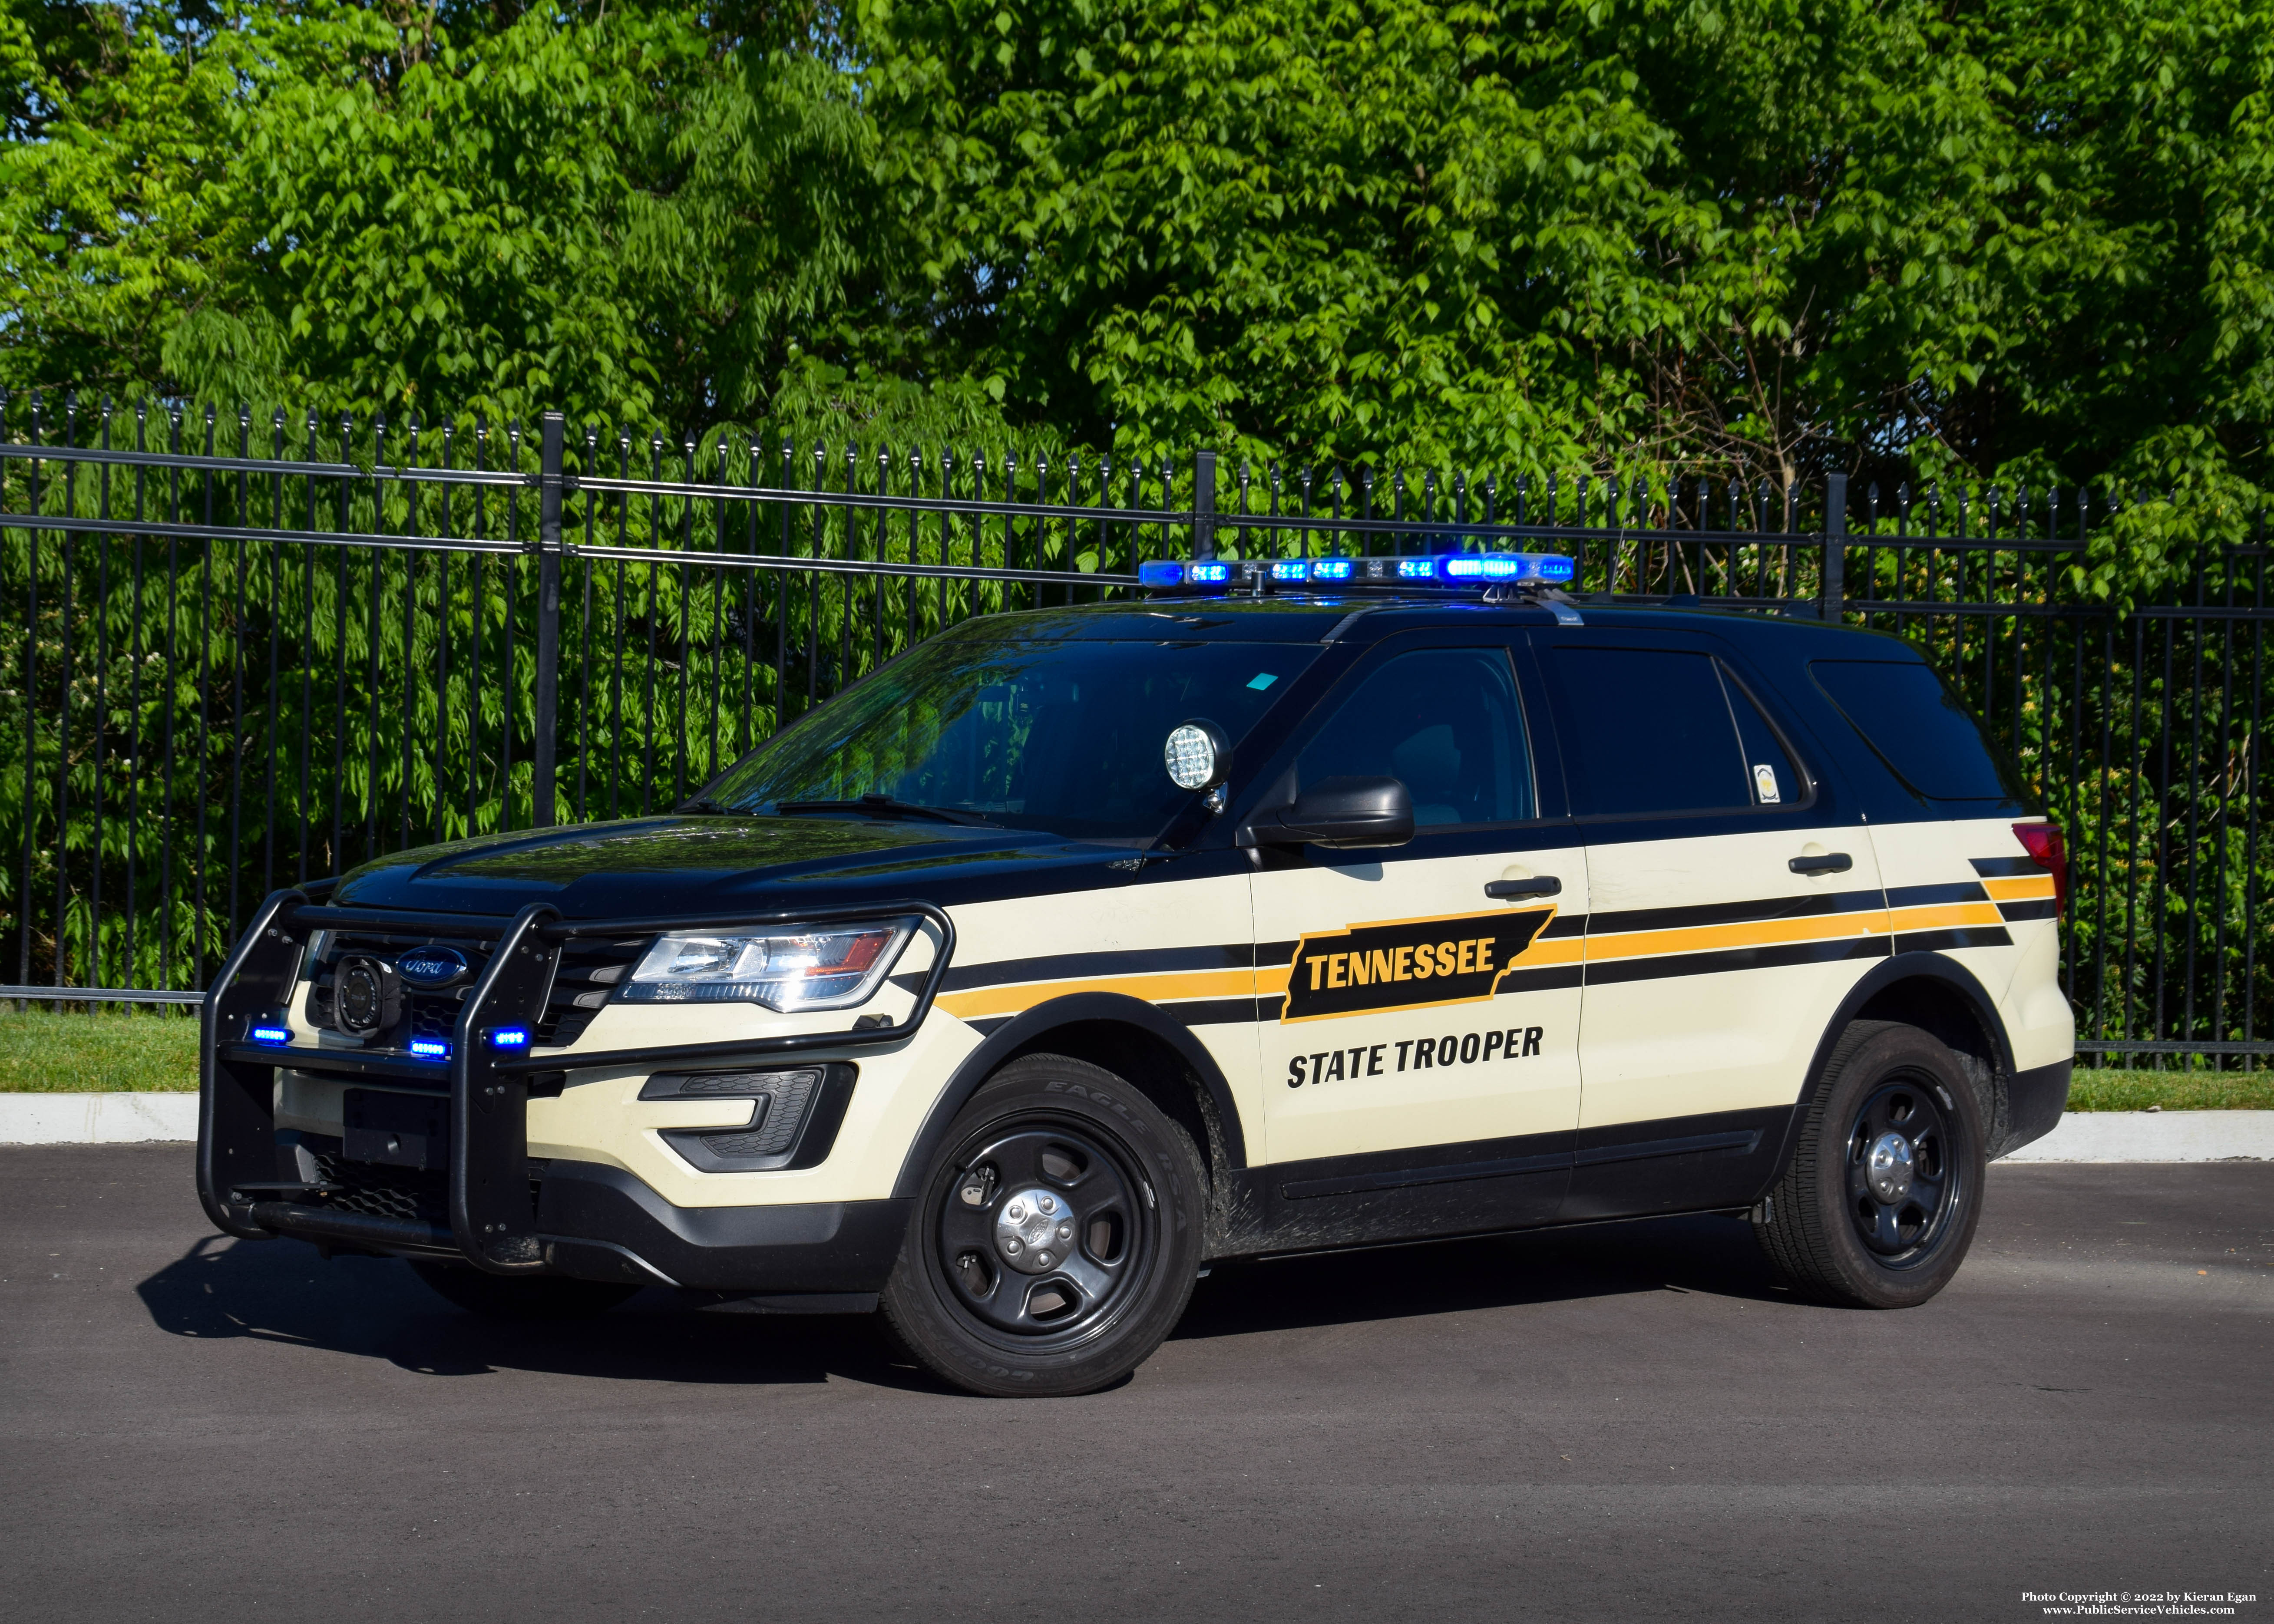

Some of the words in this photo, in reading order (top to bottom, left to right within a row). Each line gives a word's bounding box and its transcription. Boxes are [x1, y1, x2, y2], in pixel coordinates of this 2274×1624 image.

[406, 951, 447, 974] Ford
[1306, 937, 1495, 990] TENNESSEE
[1287, 1043, 1388, 1089] STATE
[1394, 1026, 1544, 1073] TROOPER
[1044, 1081, 1151, 1135] EAGLE
